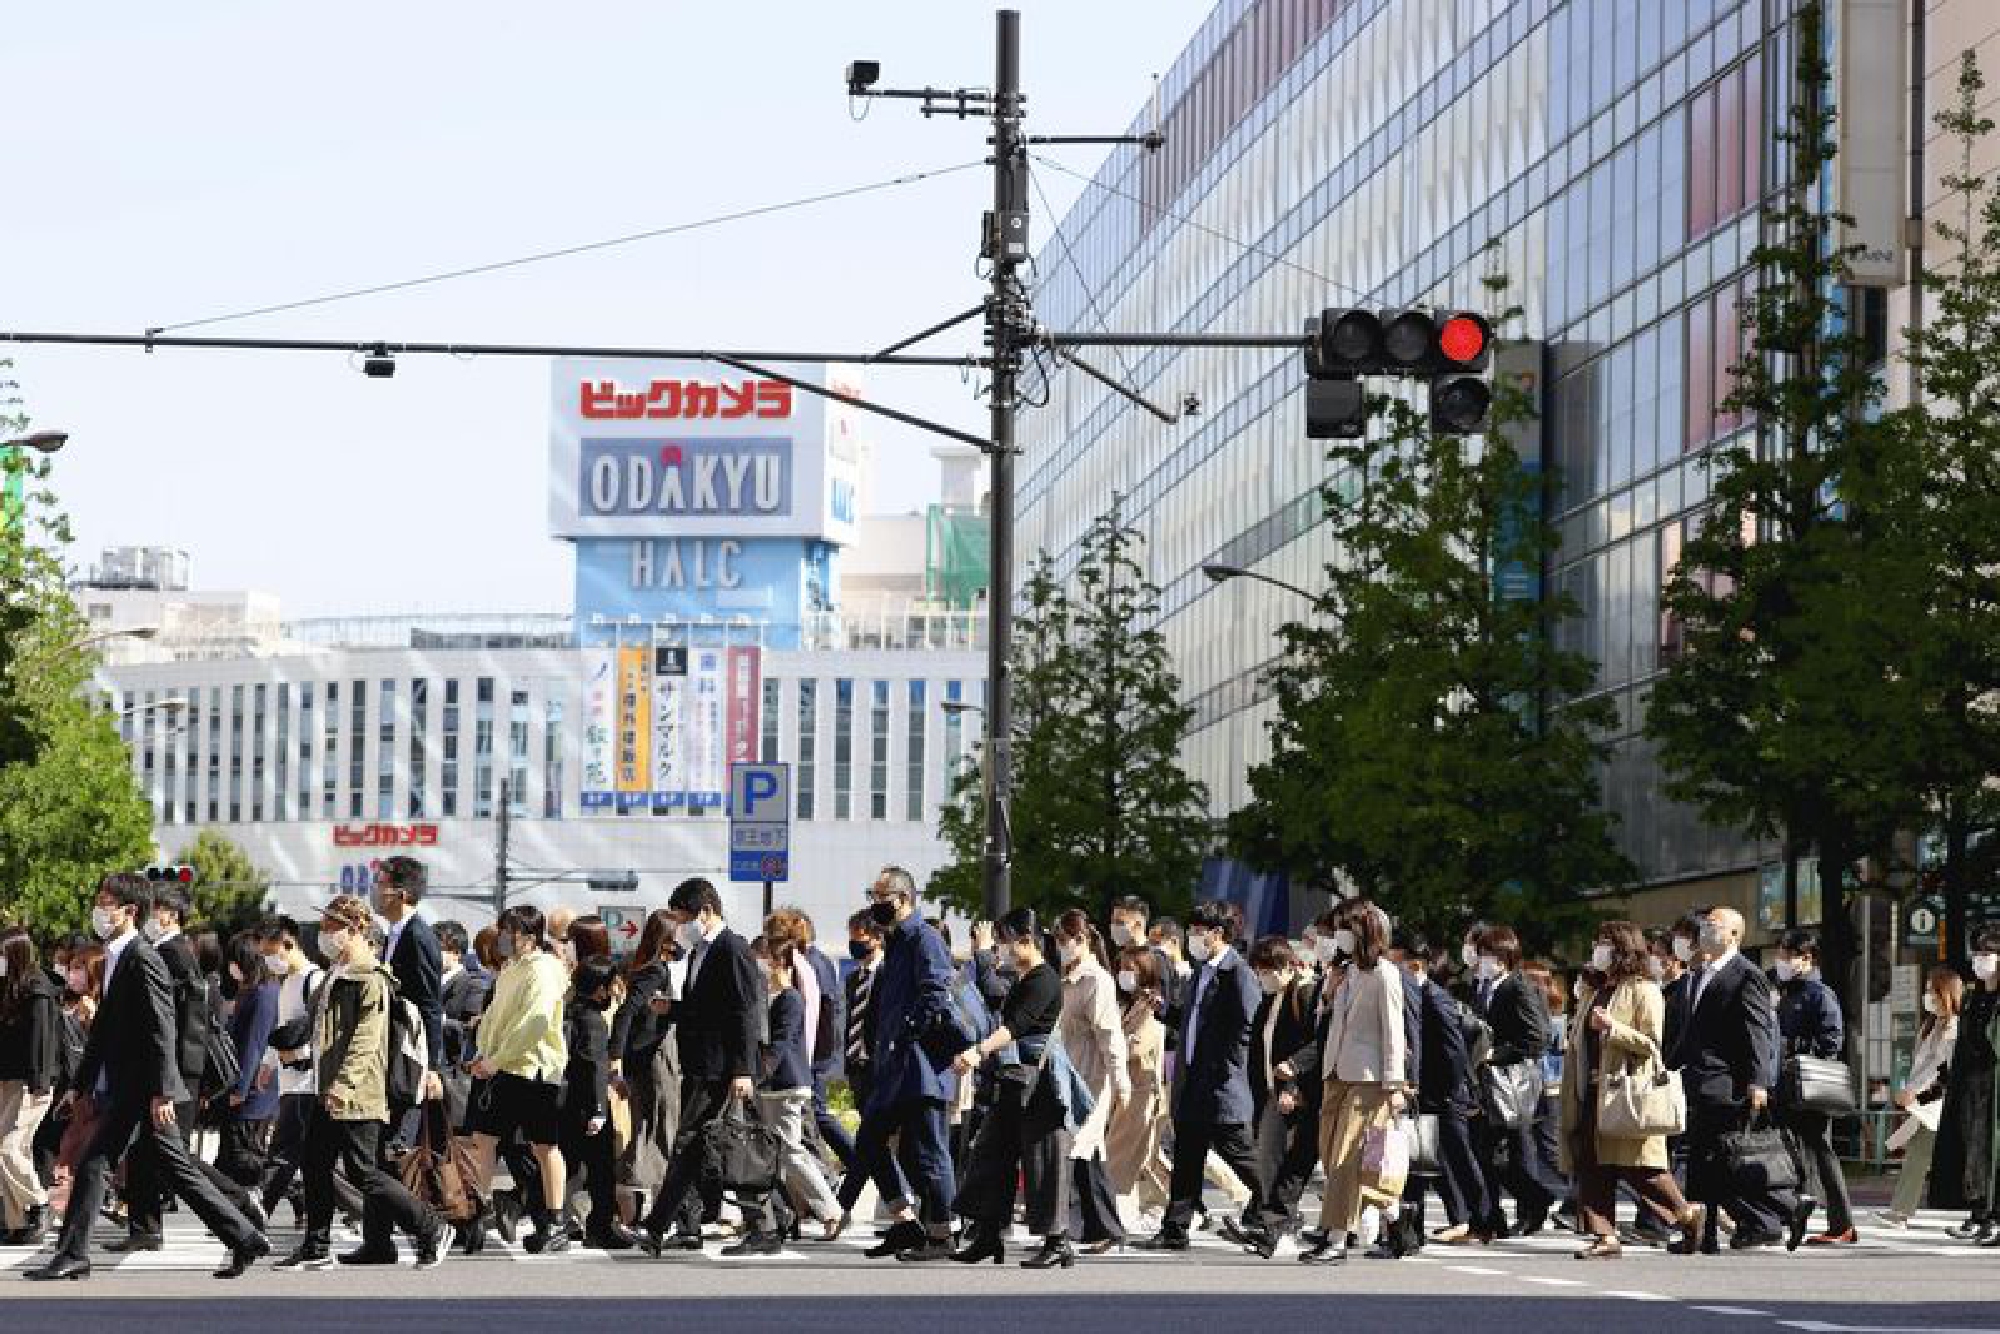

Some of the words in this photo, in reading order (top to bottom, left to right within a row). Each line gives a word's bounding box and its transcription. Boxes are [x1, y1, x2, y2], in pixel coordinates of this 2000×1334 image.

[580, 379, 794, 419] ビックカメラ
[590, 446, 782, 513] ODAKYU
[631, 540, 742, 589] HALC
[743, 771, 778, 814] P
[333, 825, 438, 847] ビックカメラ
